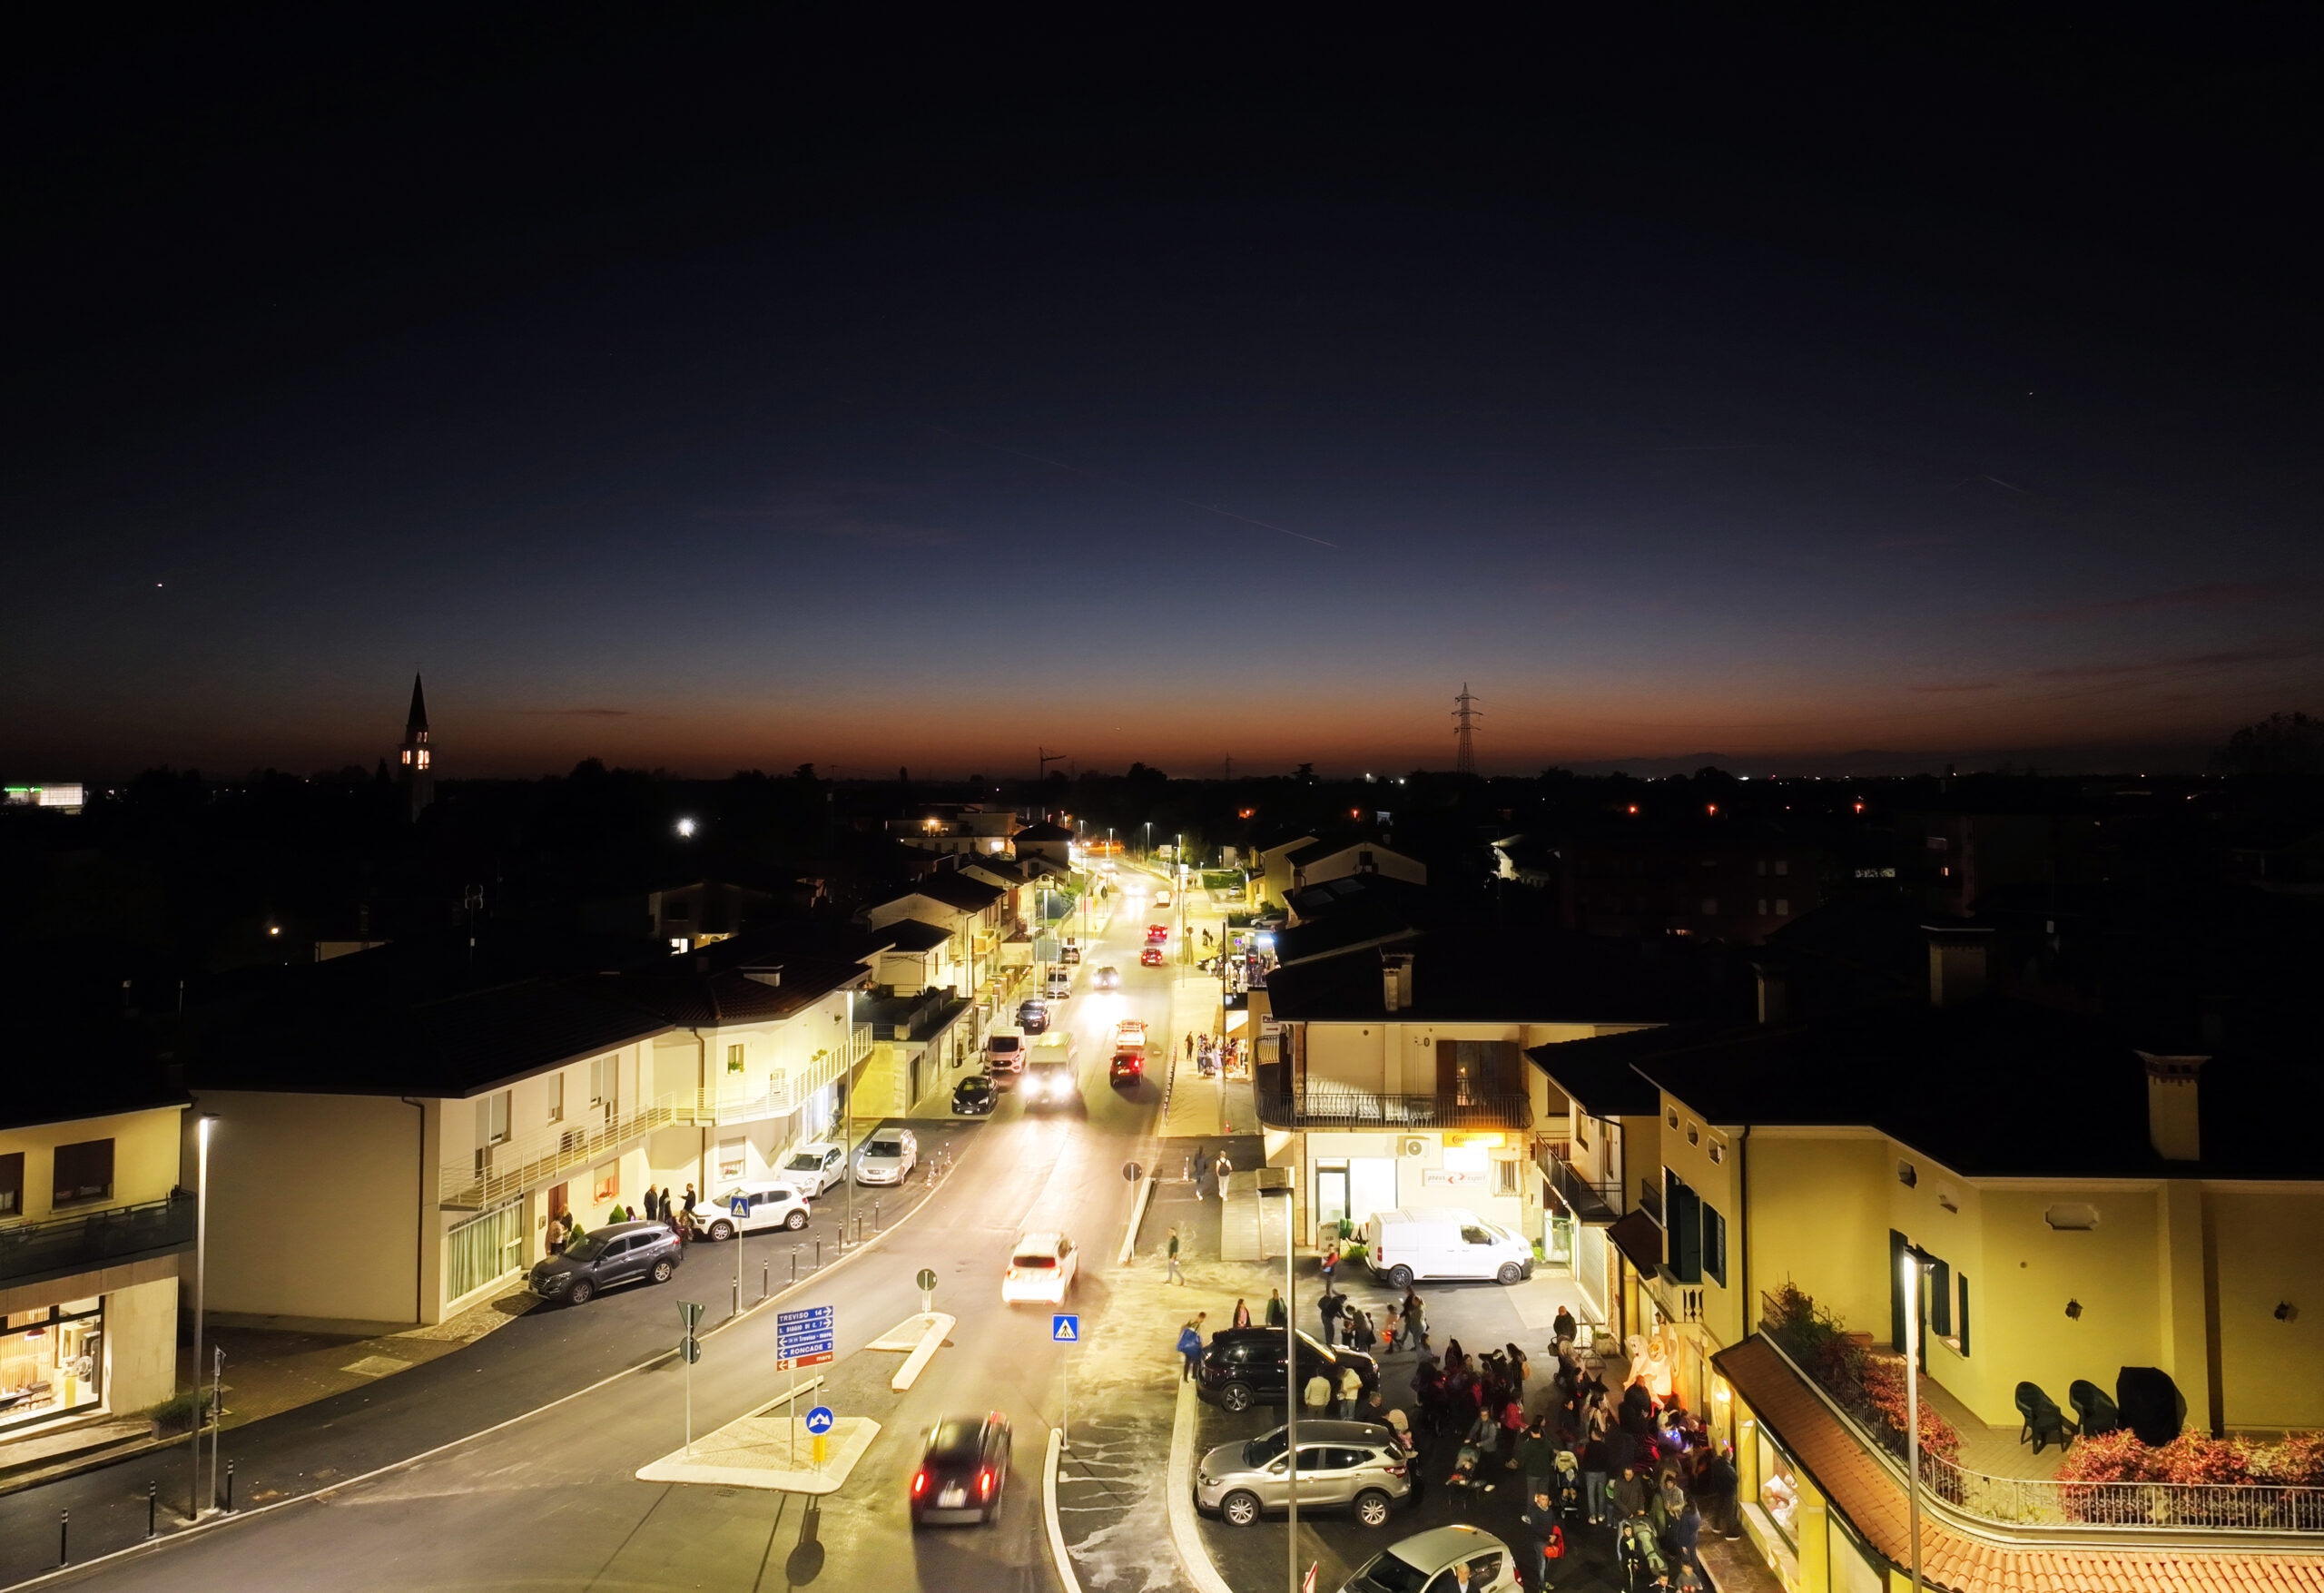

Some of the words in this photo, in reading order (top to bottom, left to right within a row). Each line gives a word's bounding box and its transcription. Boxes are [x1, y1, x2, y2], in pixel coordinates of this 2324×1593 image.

[779, 1312, 809, 1322] TREVISO
[786, 1324, 803, 1332] BIAGIO
[790, 1343, 823, 1355] RONCADE
